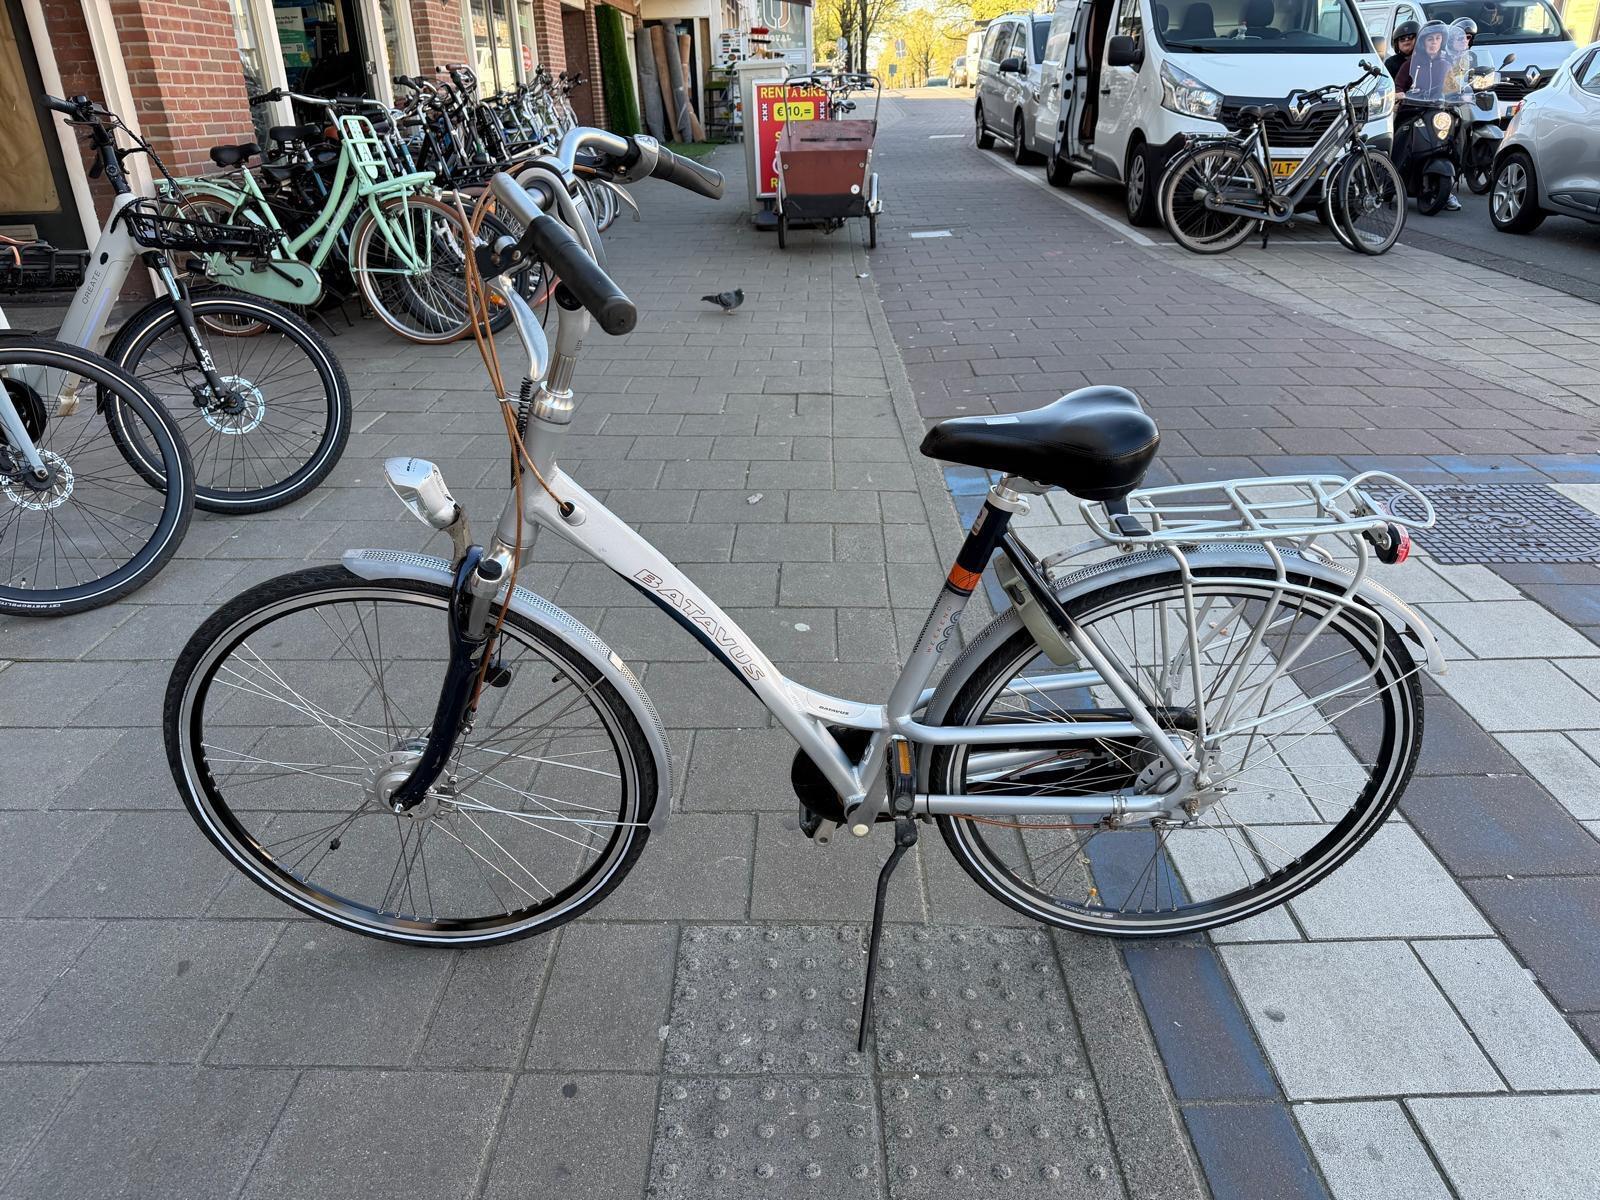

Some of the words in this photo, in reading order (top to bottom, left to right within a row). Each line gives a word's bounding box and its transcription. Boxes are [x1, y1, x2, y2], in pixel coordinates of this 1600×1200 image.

[760, 86, 789, 98] RENT
[791, 88, 798, 97] A
[633, 568, 765, 681] BATAVUS
[818, 705, 849, 715] BATAVUS
